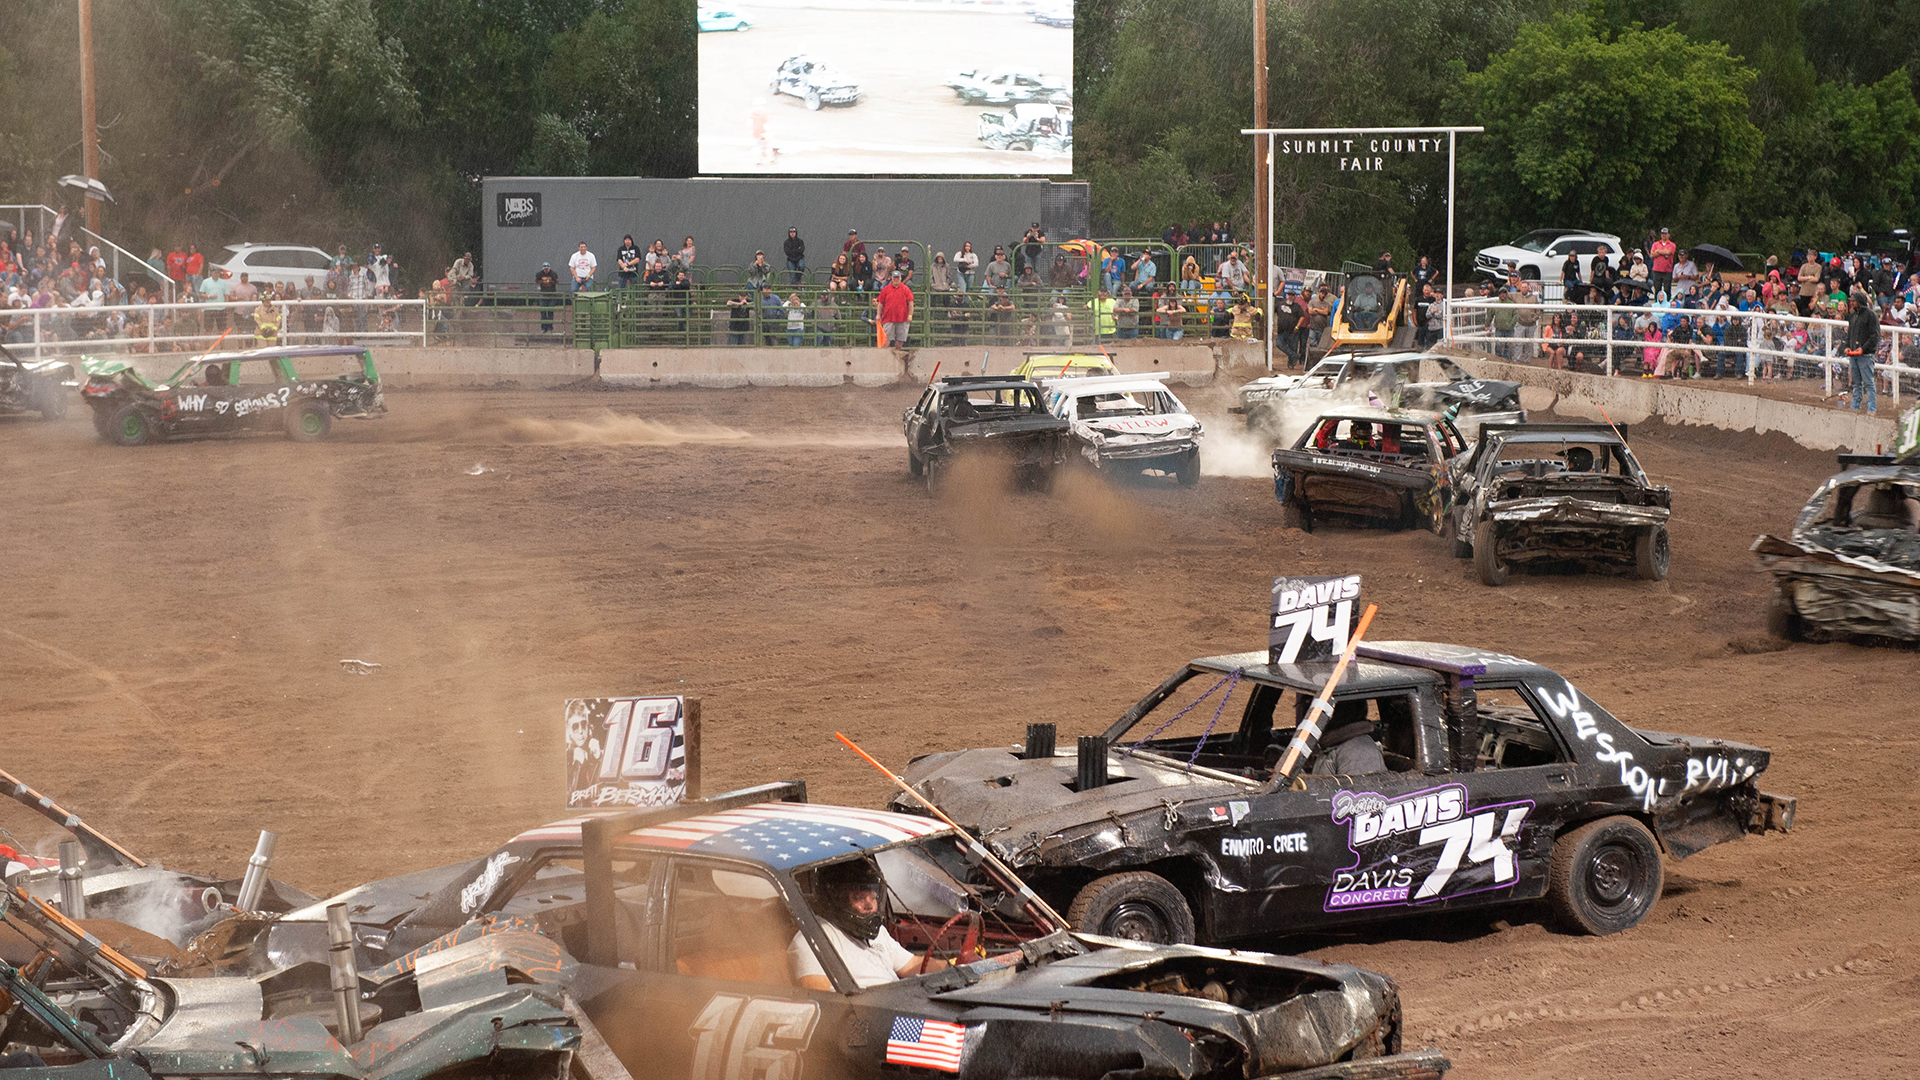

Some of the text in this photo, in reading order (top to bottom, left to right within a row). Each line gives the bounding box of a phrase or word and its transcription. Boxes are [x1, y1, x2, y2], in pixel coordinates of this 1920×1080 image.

[1282, 139, 1442, 154] SUMMIT COUNTY
[1340, 157, 1383, 171] FAIR
[178, 394, 207, 411] WHY
[1277, 575, 1362, 615] DAVIS
[1274, 599, 1353, 664] 74
[600, 697, 680, 783] 16
[1537, 677, 1666, 812] WESTON
[569, 782, 686, 807] BRETT BERMAN
[1353, 787, 1463, 847] DAVIS
[1221, 837, 1264, 858] ENVIRO
[1273, 832, 1309, 853] CRETE
[1413, 807, 1530, 900] 74
[1330, 888, 1408, 906] CONCRETE
[1332, 868, 1414, 893] DAVIS
[688, 991, 821, 1080] 16
